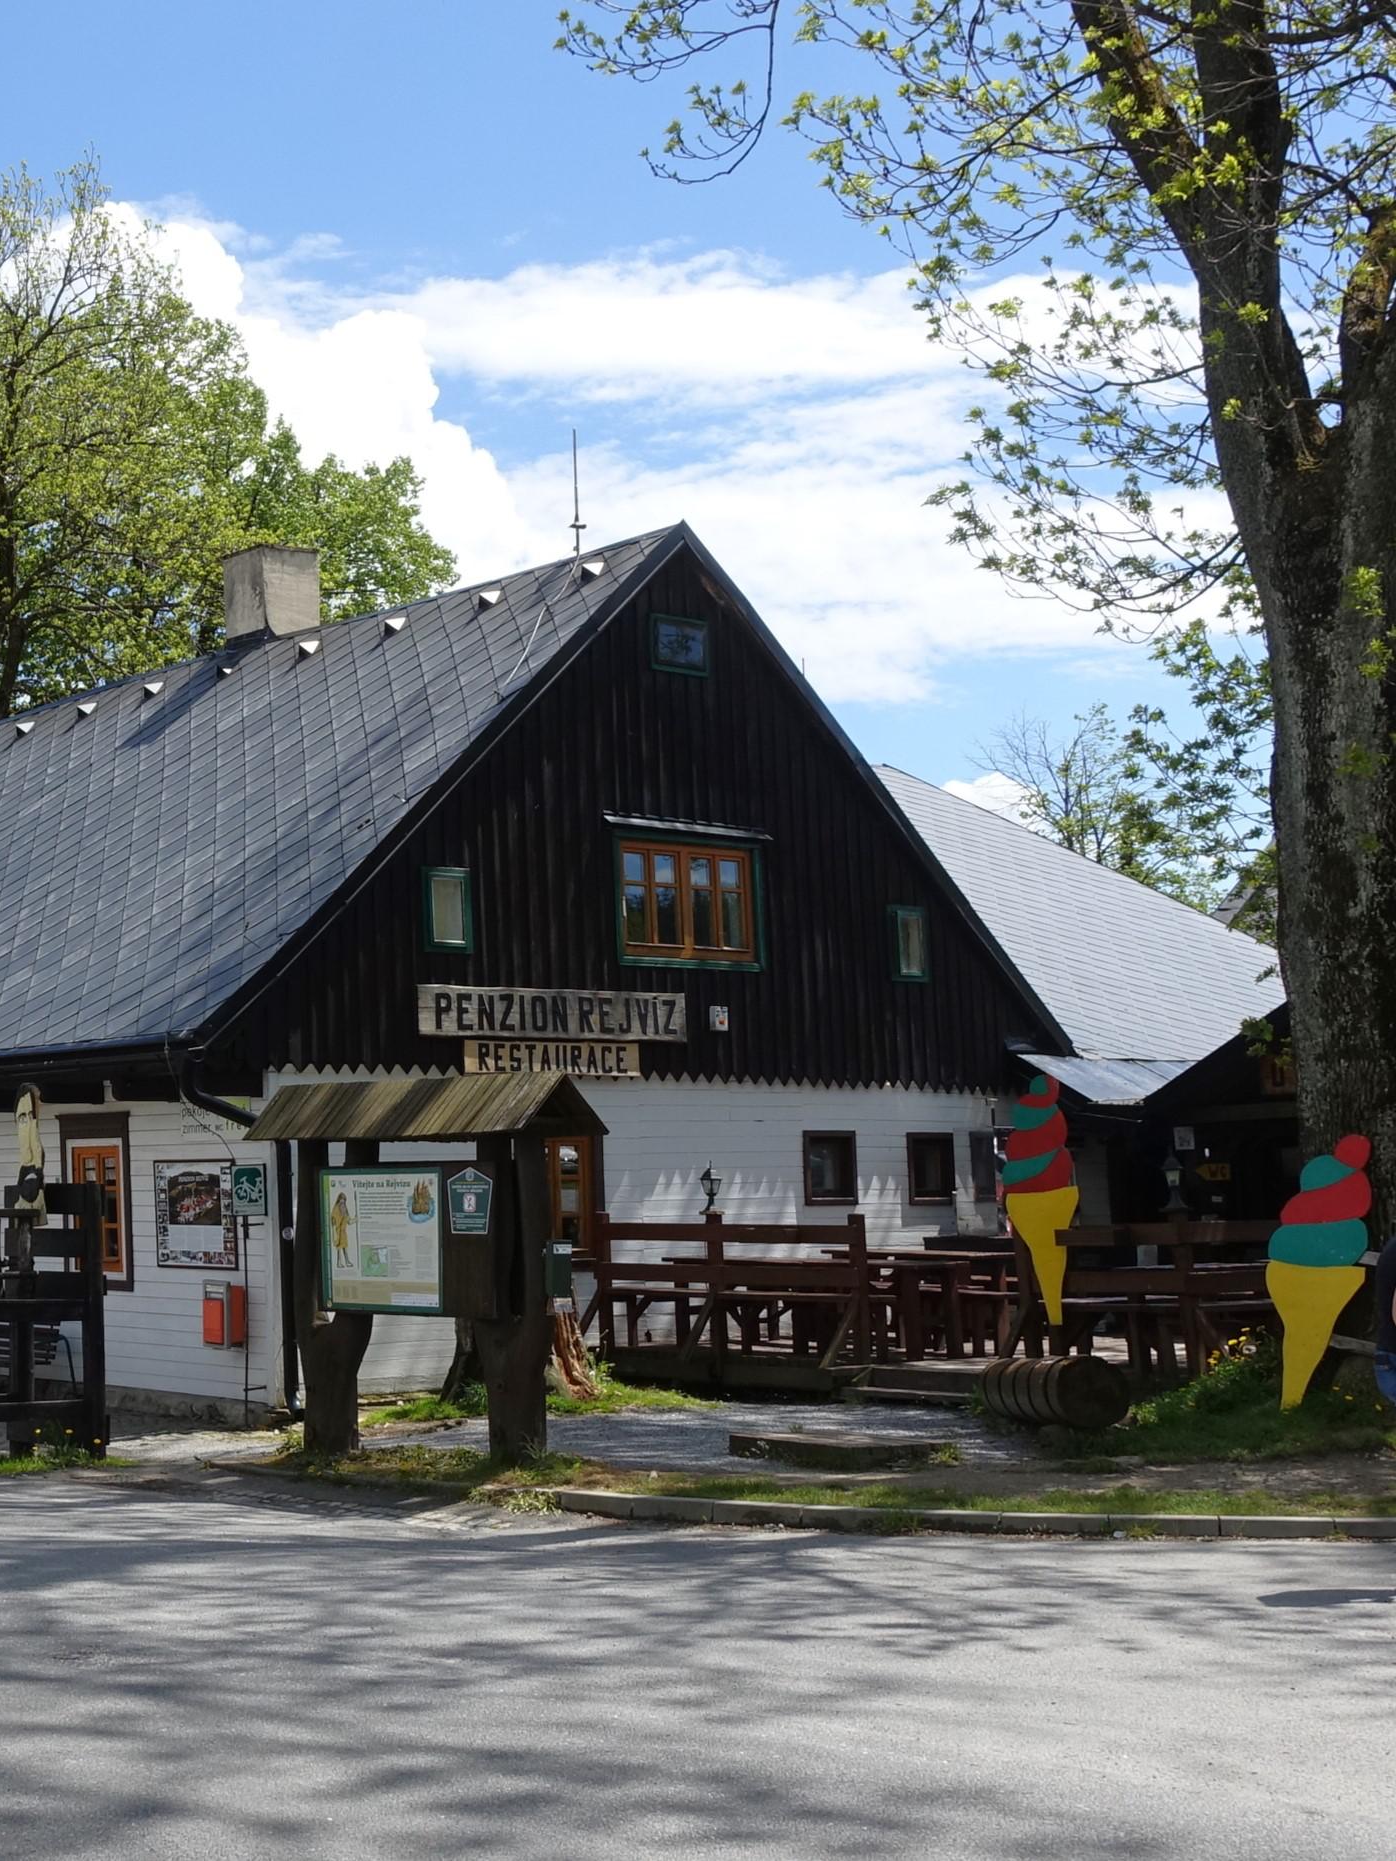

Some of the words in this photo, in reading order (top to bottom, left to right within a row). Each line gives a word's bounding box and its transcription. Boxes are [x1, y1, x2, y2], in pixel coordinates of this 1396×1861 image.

[434, 992, 569, 1033] PENZION
[477, 1042, 628, 1074] RESTAURACE
[1208, 1165, 1228, 1178] WC
